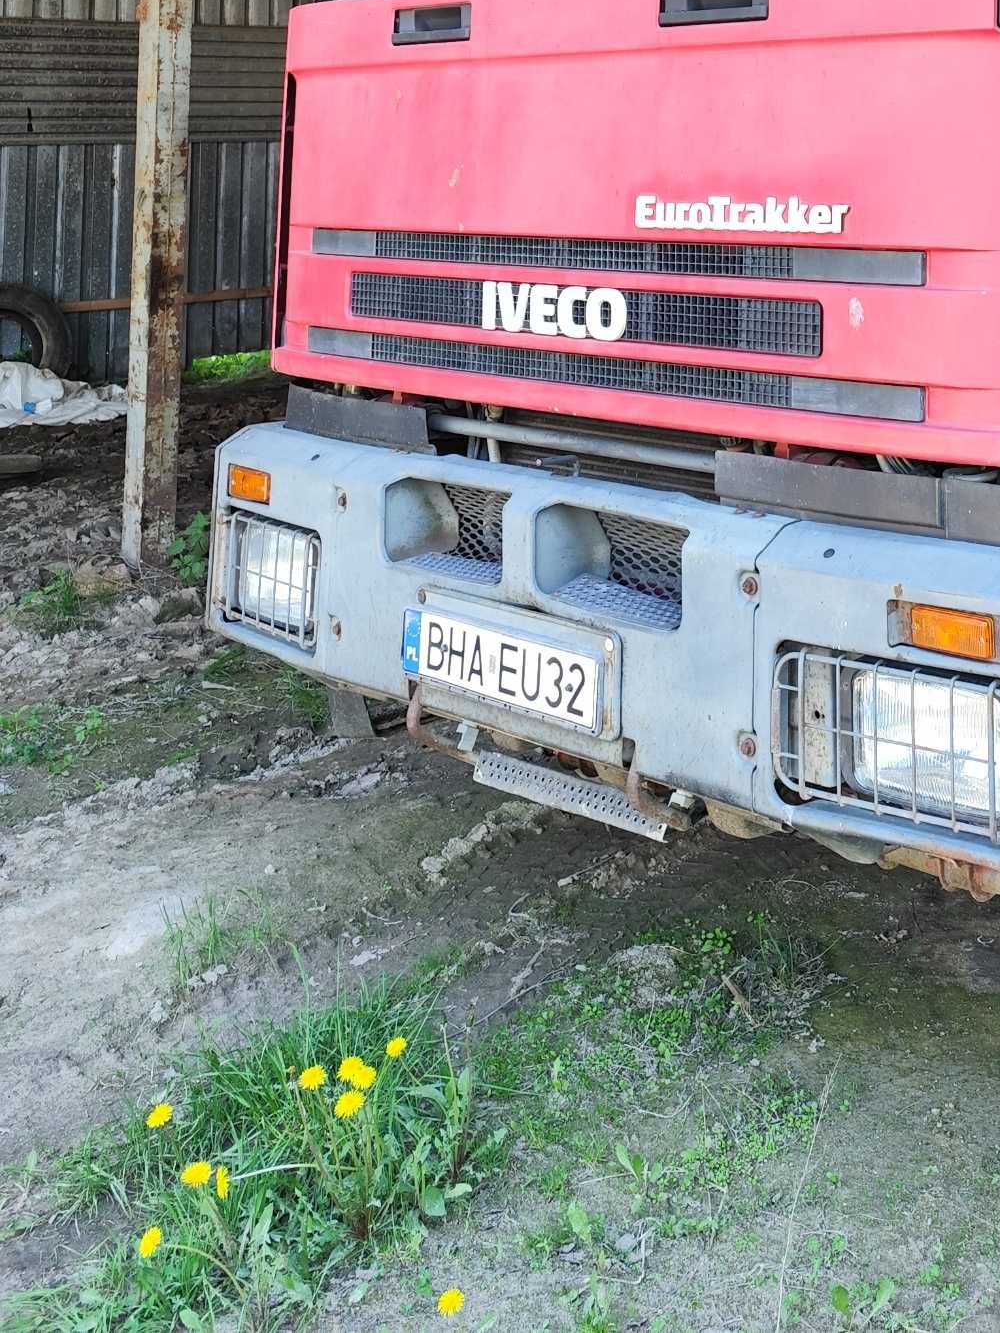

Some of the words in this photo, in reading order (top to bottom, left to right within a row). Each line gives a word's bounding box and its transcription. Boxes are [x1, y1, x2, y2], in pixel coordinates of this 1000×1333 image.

[635, 195, 849, 233] EuroTrakker
[481, 281, 627, 341] IVECO
[406, 647, 418, 662] PL
[426, 621, 484, 687] BHA
[498, 642, 586, 717] EU32
